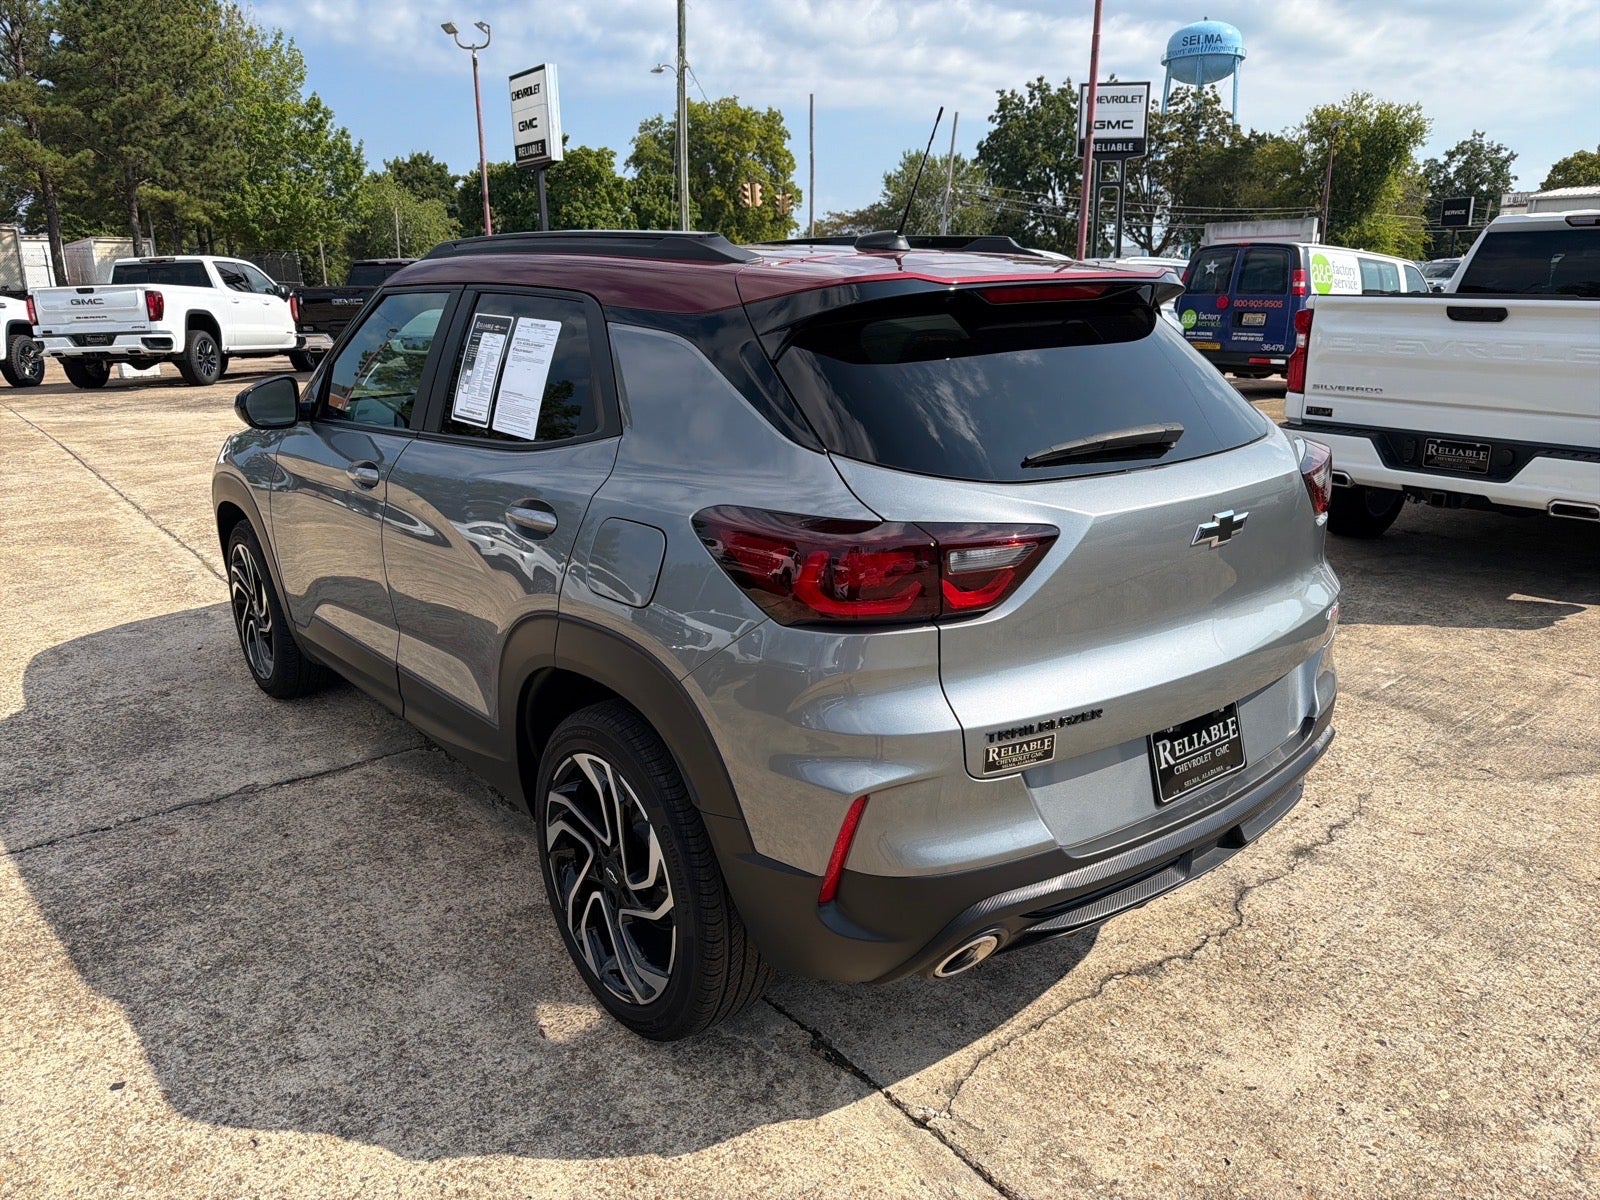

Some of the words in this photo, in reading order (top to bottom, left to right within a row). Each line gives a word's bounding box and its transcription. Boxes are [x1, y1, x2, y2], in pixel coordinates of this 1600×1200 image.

[1182, 34, 1223, 46] SELMA
[511, 83, 540, 101] CHEVROLET
[1086, 95, 1143, 104] EVROLET
[518, 117, 538, 132] GMC
[1093, 120, 1134, 130] GMC
[518, 143, 542, 158] RELIABLE
[1332, 261, 1356, 280] factory
[71, 298, 104, 306] GMC
[1233, 299, 1283, 308] 800-905-9505
[1198, 311, 1222, 322] factory
[1261, 343, 1285, 352] 36479
[1328, 335, 1600, 364] CHEVROLE
[1312, 383, 1383, 394] SILVERADO
[1426, 443, 1488, 461] RELIABLE
[985, 708, 1104, 743] TRAILBLAZER
[988, 738, 1052, 762] RELIABLE
[1156, 716, 1239, 770] RELIABLE
[995, 753, 1031, 766] CHEVROLET
[1030, 750, 1045, 759] GMC
[1174, 751, 1212, 775] CHEVROLET
[1215, 743, 1230, 757] GMC
[1201, 765, 1224, 779] ALABAMA
